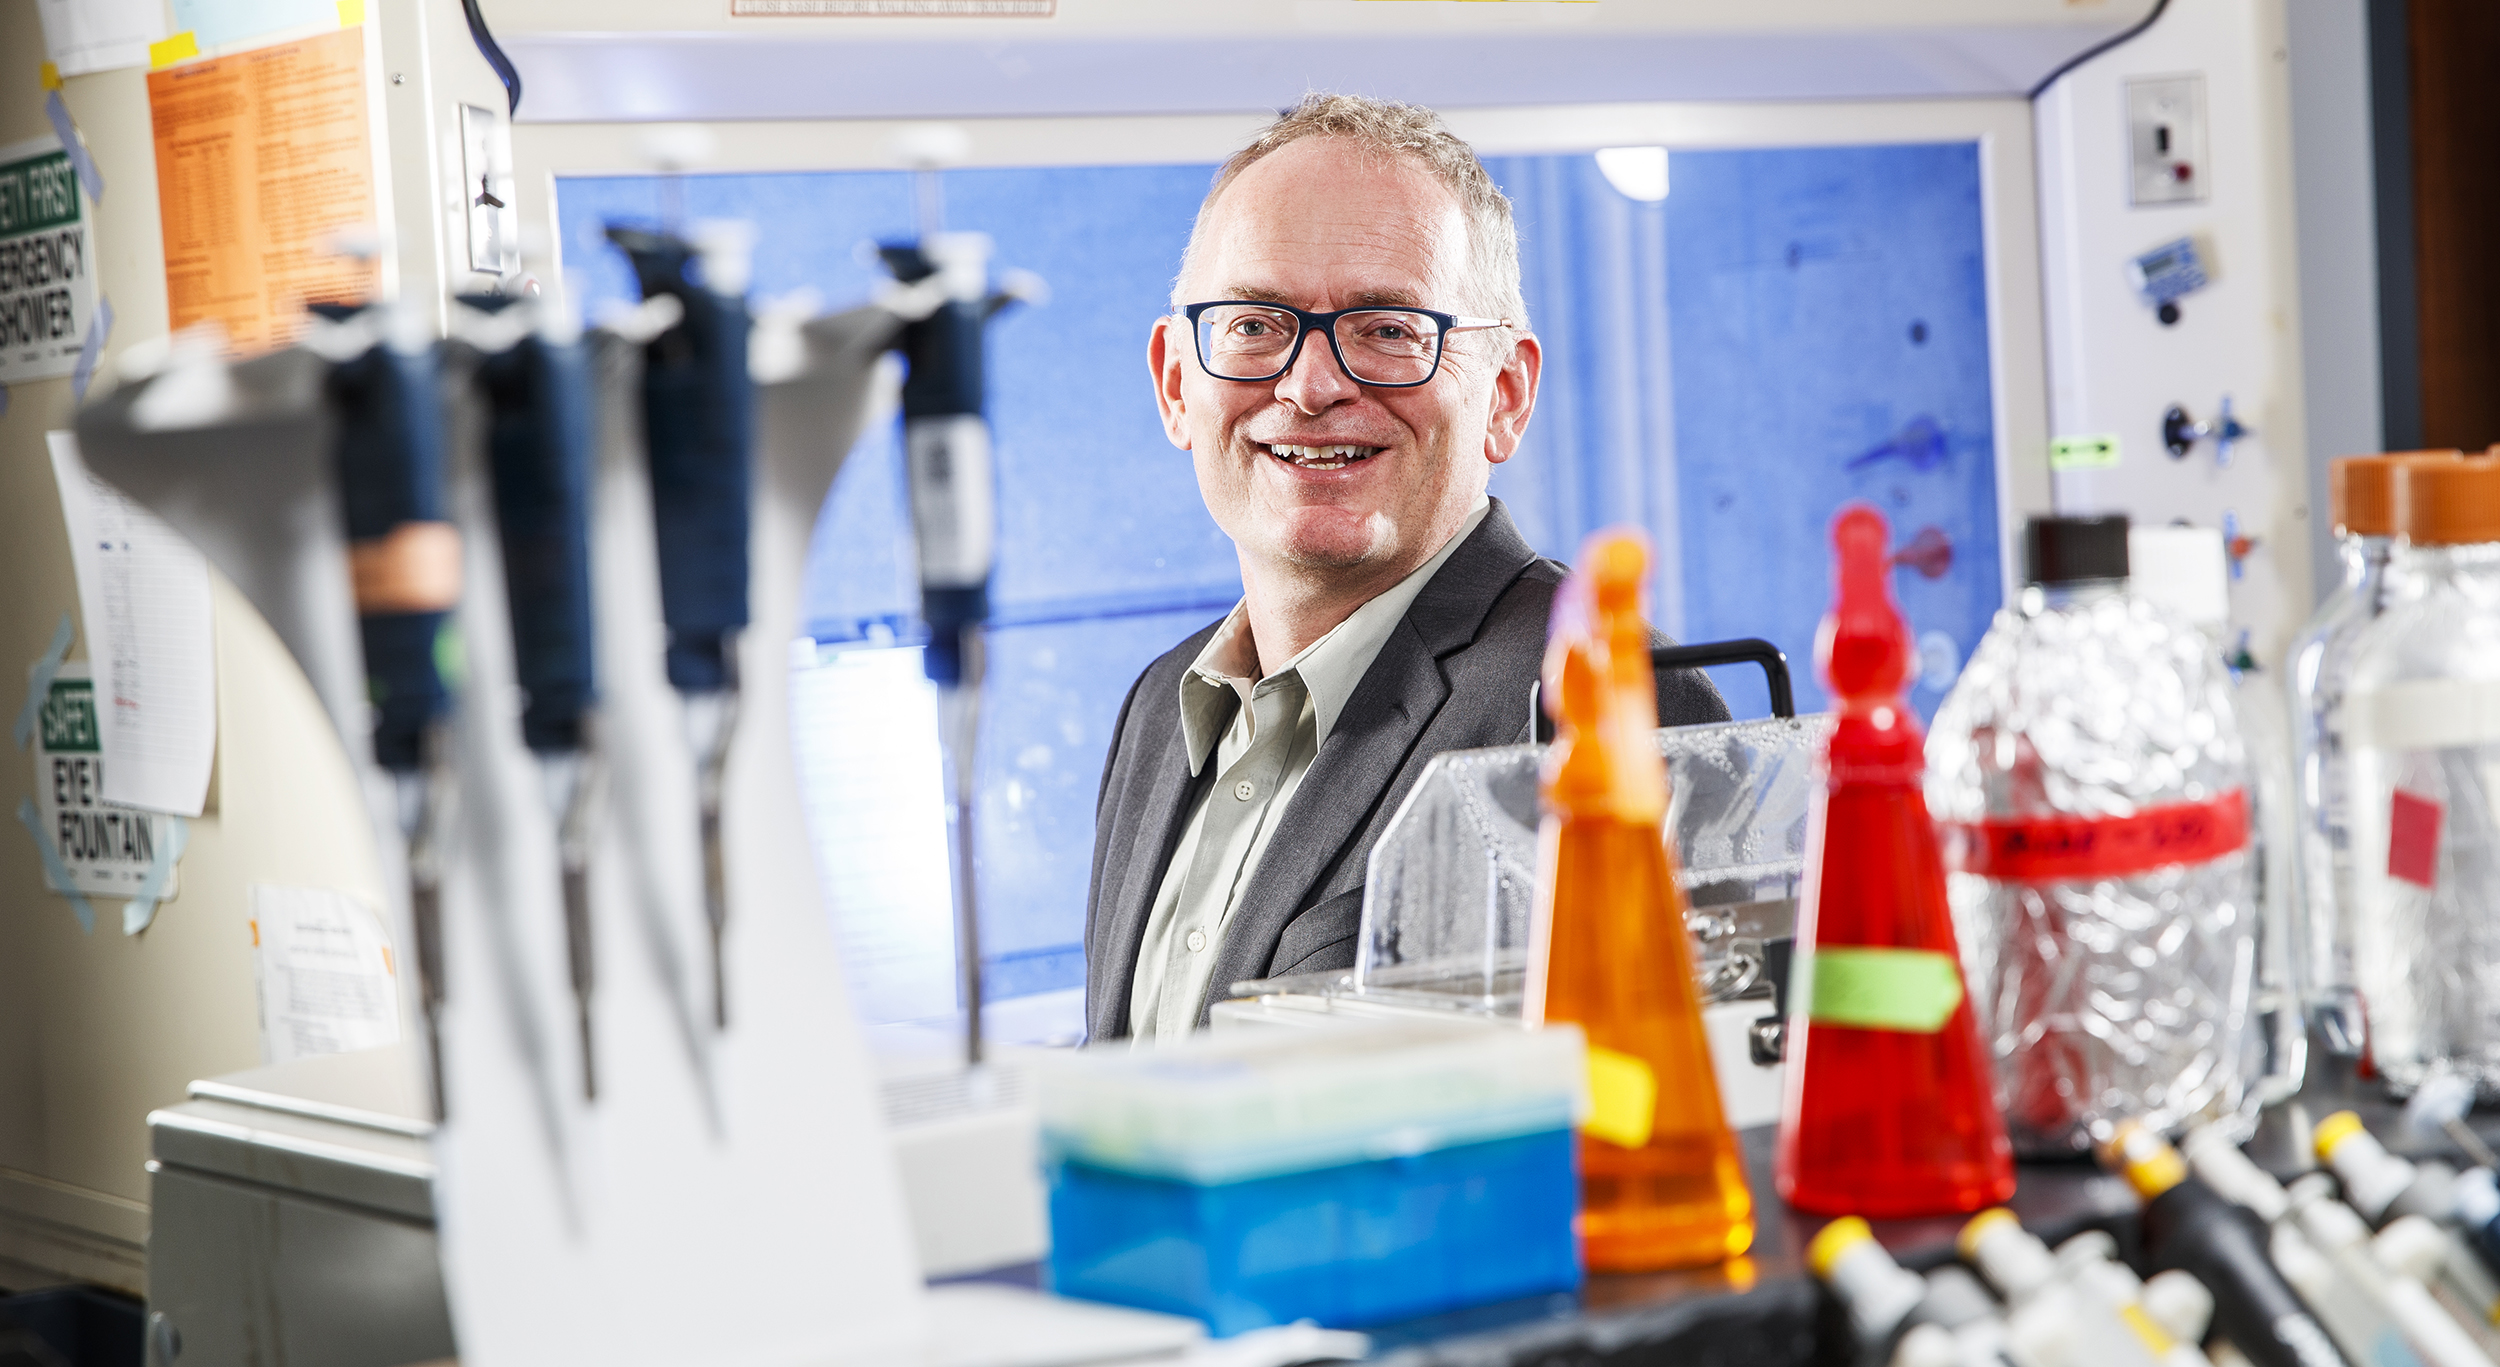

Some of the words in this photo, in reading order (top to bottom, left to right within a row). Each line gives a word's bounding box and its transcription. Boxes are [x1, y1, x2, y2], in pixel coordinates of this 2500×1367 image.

[30, 159, 76, 223] FIRST
[53, 757, 92, 806] EYE
[57, 812, 155, 862] FOUNTAIN
